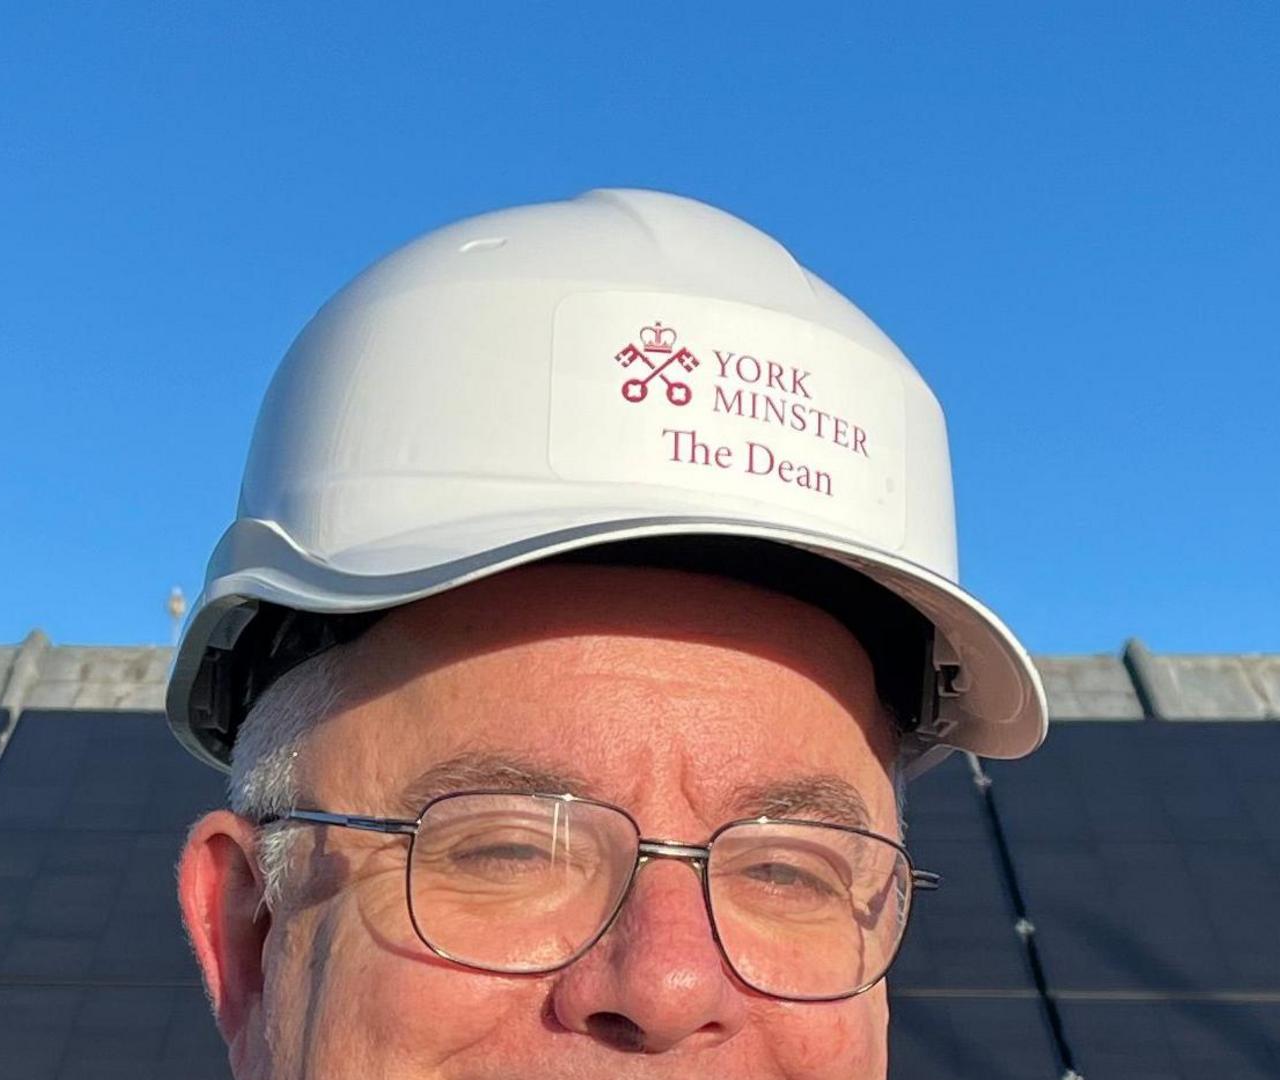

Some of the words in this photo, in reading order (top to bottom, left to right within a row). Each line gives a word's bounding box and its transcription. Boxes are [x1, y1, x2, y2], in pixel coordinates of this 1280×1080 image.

[713, 350, 812, 399] YORK
[713, 385, 870, 458] MINSTER
[662, 428, 733, 469] The
[745, 441, 834, 496] Dean
